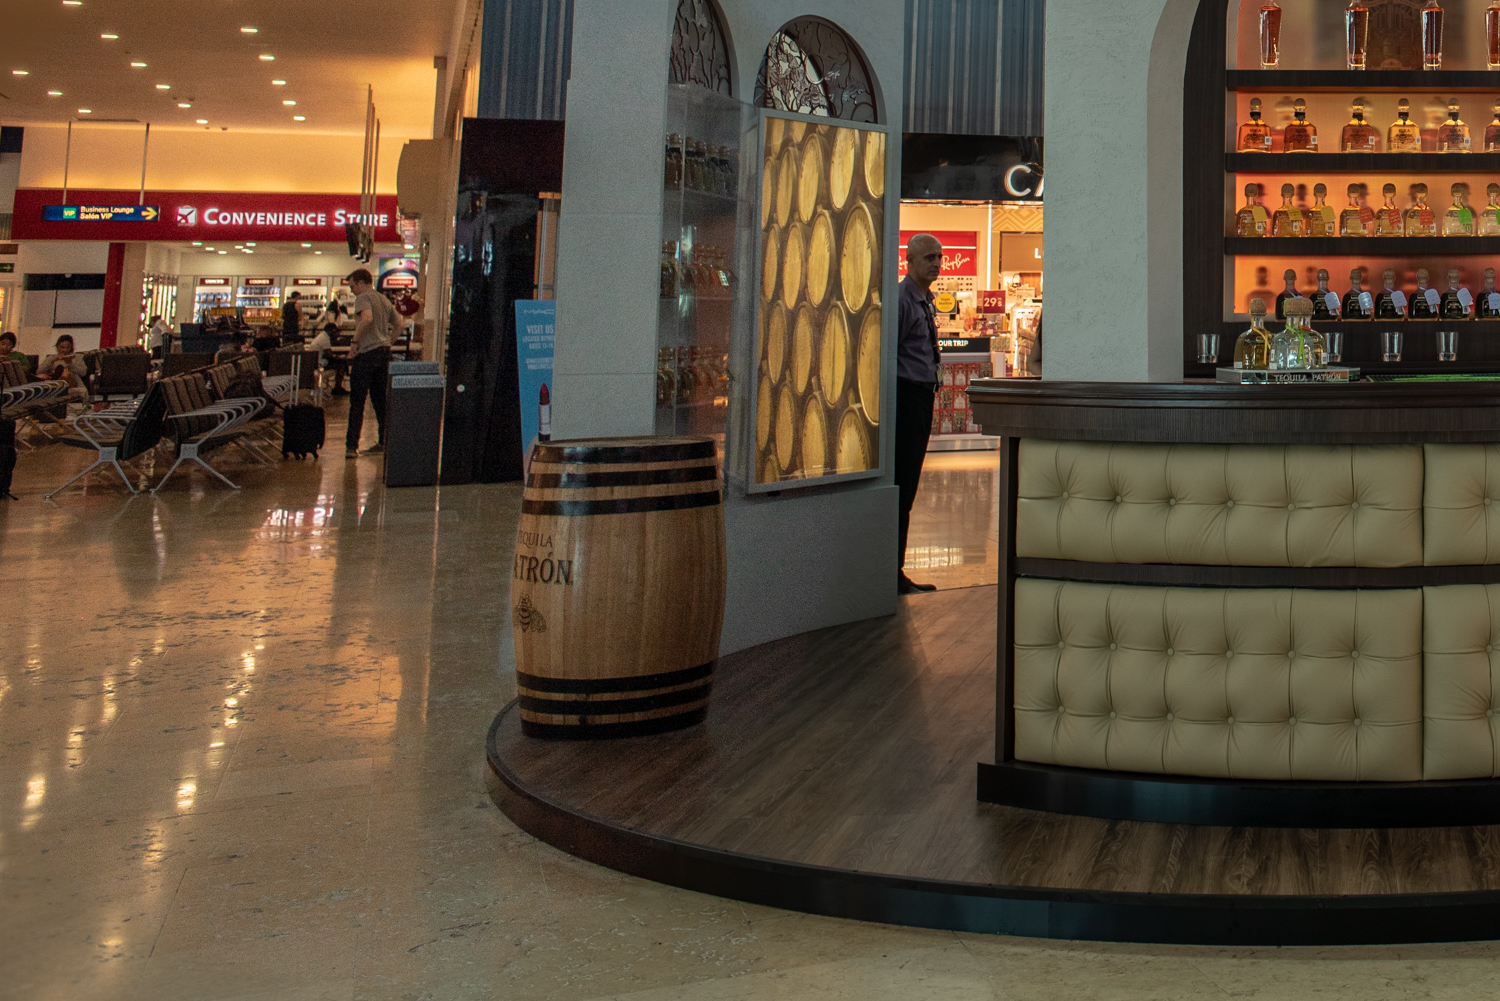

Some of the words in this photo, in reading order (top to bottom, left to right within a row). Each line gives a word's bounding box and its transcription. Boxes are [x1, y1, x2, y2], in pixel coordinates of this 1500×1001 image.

[1004, 163, 1044, 197] C
[80, 206, 109, 214] Business
[110, 206, 134, 215] Lounge
[526, 324, 543, 334] VISIT
[1311, 373, 1342, 382] PATRÓN
